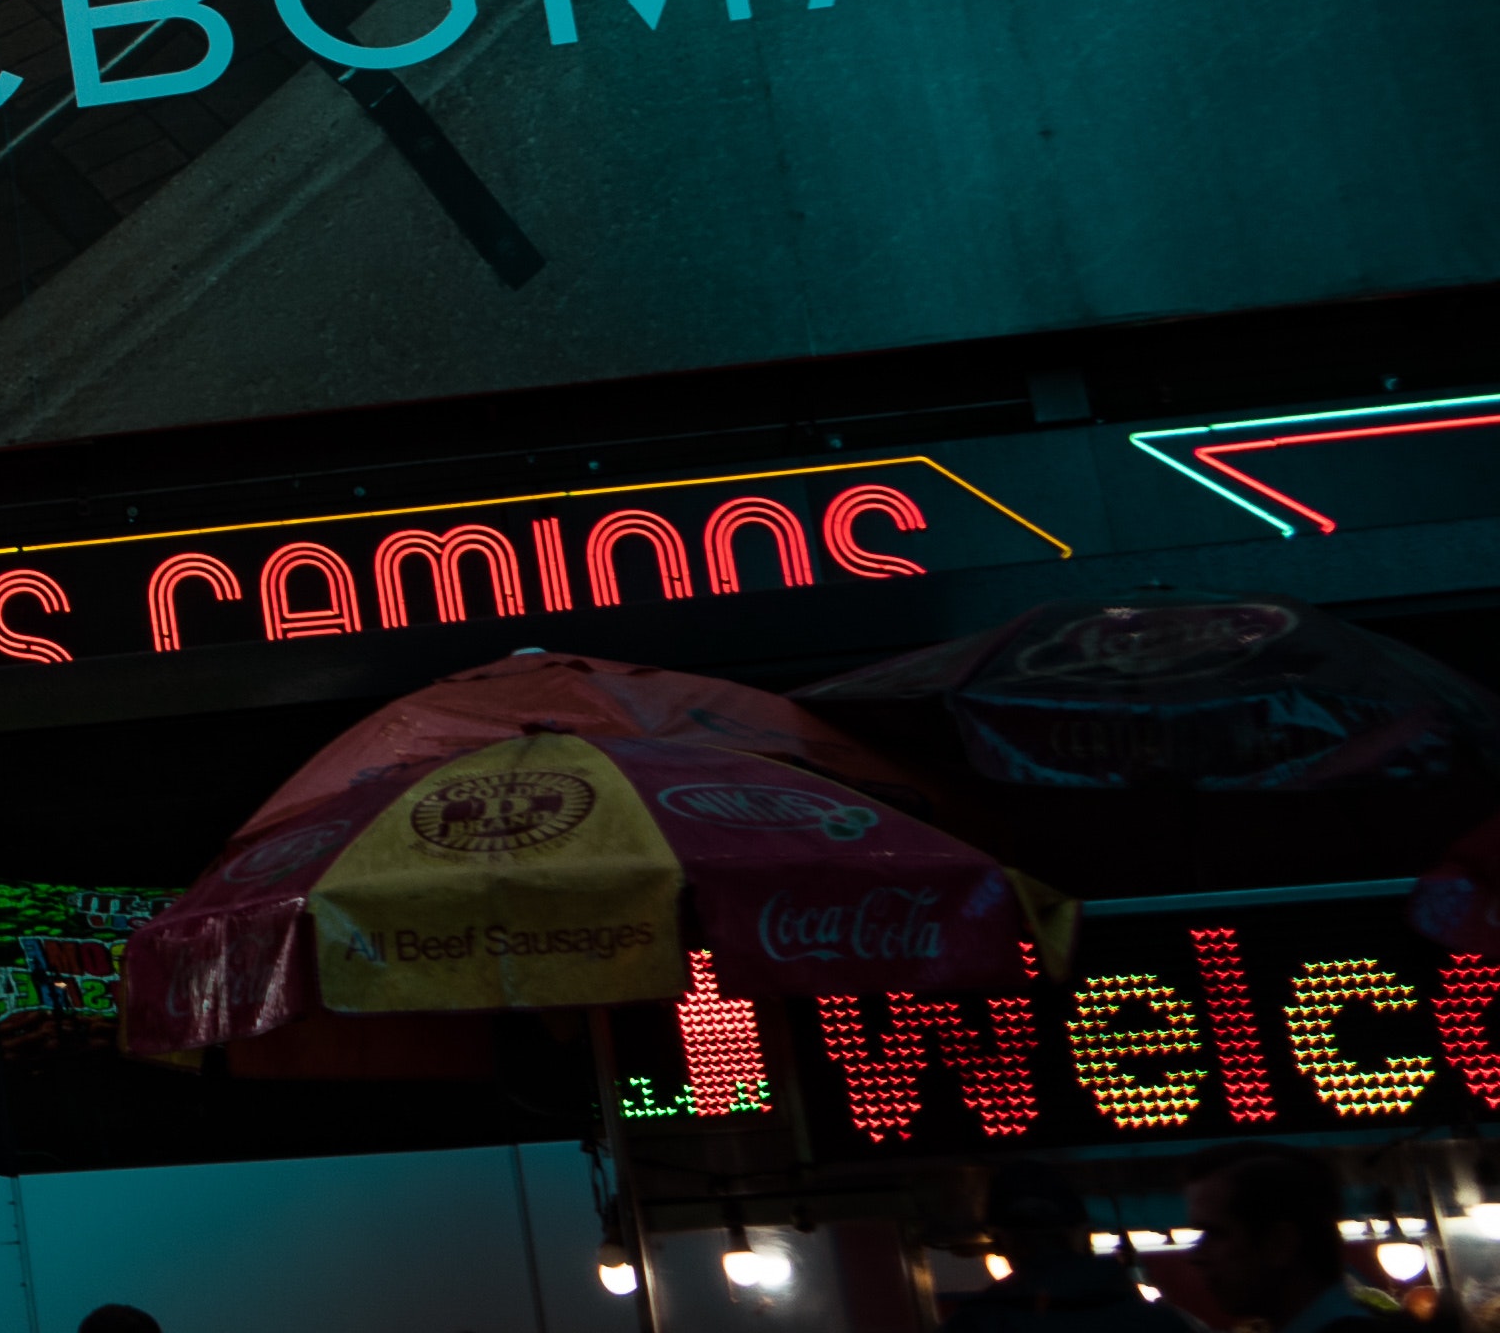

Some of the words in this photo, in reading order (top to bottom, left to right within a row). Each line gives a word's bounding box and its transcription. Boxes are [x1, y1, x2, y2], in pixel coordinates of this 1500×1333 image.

[345, 931, 386, 963] All
[395, 927, 477, 962] Beef
[485, 920, 653, 960] Sausages
